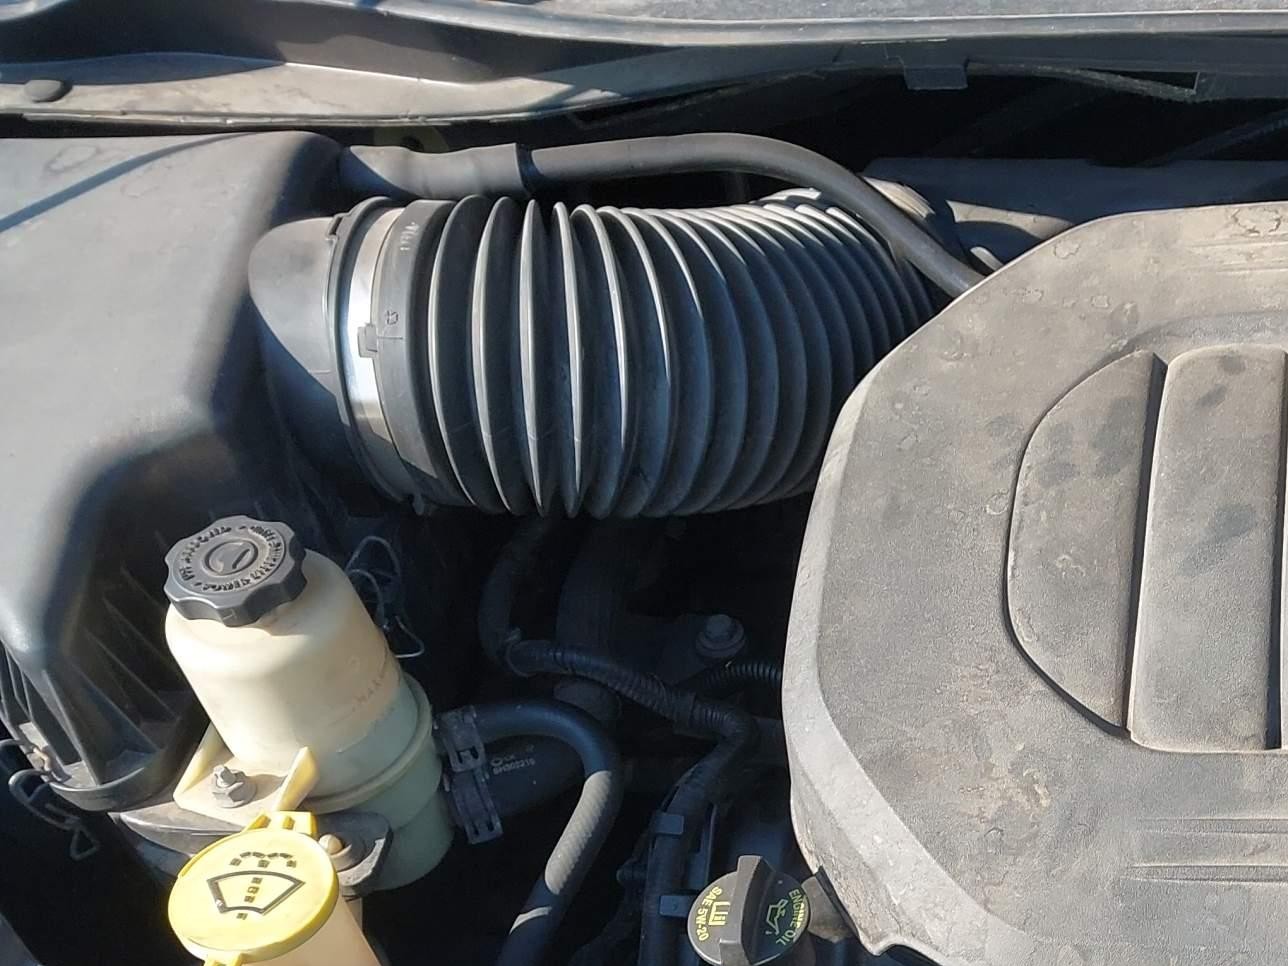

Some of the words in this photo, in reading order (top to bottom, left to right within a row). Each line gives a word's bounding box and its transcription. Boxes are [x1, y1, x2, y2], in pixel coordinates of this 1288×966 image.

[702, 886, 724, 910] SAE
[789, 888, 807, 929] ENGINE
[697, 908, 709, 941] 5W-20
[775, 927, 797, 946] OIL
